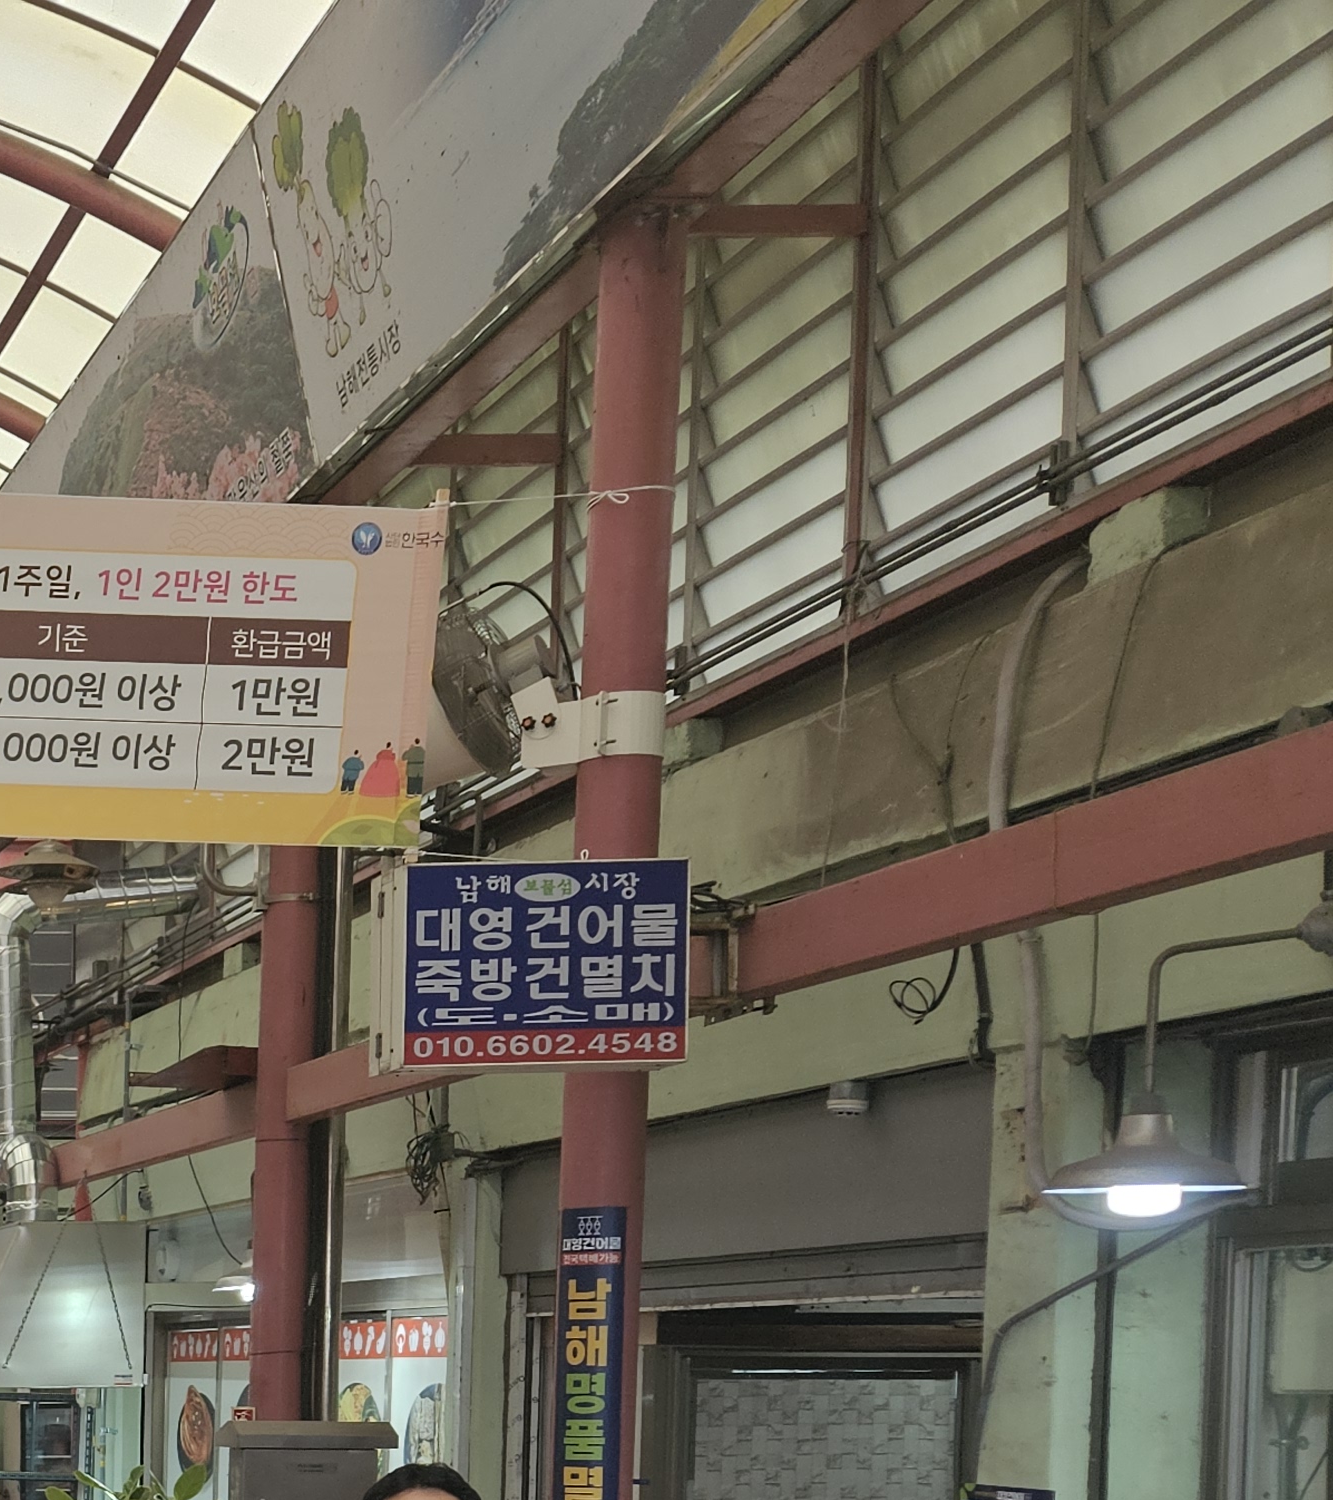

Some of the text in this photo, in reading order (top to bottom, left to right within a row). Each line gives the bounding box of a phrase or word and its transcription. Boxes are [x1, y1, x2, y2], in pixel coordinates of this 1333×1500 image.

[334, 320, 402, 411] 남해전통시장
[97, 567, 142, 603] 1인
[151, 567, 232, 606] 2만원
[242, 571, 298, 605] 한도
[37, 621, 89, 655] 기준
[229, 628, 332, 661] 환급금액
[115, 669, 182, 712] 이상
[230, 676, 321, 718] 1만원
[110, 730, 174, 772] 이상
[220, 736, 316, 778] 2만원
[455, 871, 641, 903] 남해 보물섬 시장
[414, 902, 679, 952] 대영건어물
[414, 953, 676, 1003] 죽방건멸치
[412, 1031, 678, 1059] 010.6602.4548
[562, 1236, 622, 1252] 대영건어물
[563, 1252, 620, 1266] 전국택배가능
